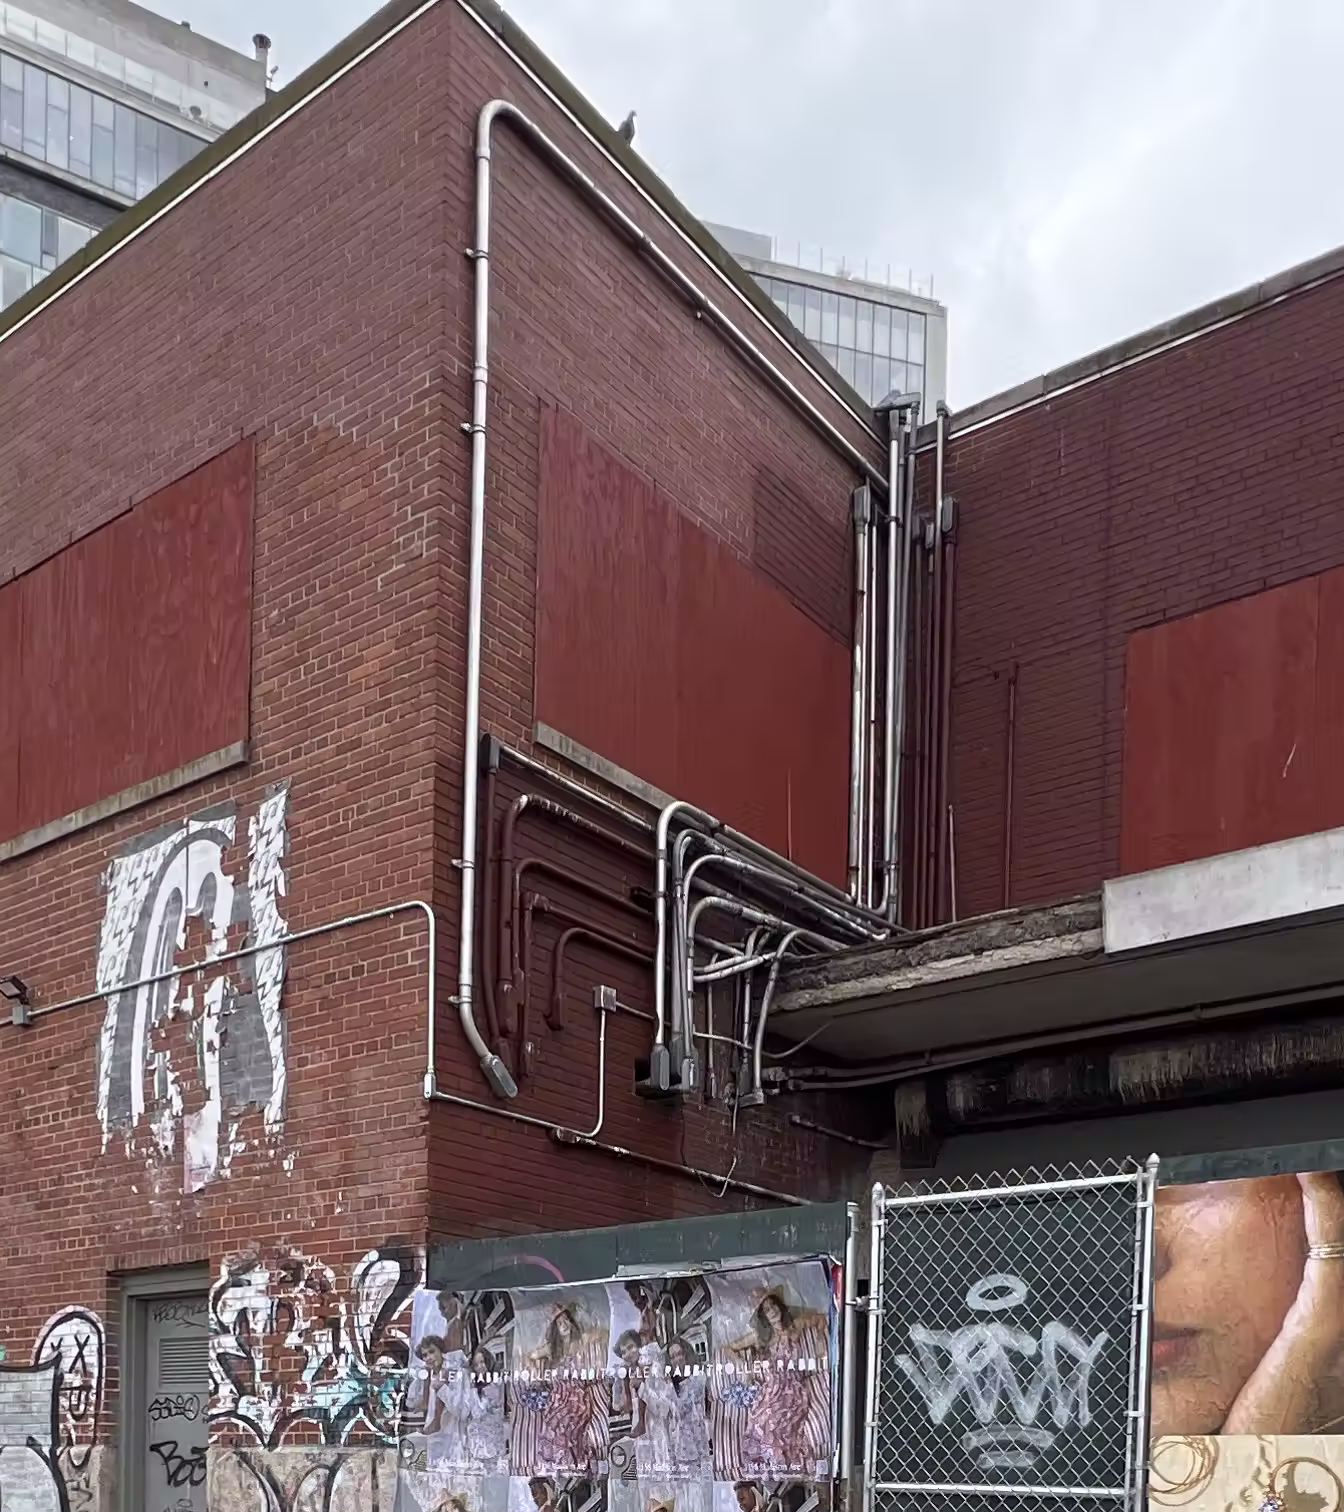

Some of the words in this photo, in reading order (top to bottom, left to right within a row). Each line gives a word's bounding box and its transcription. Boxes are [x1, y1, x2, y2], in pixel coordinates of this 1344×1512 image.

[664, 1363, 713, 1378] RABBIT
[715, 1360, 770, 1375] ROLLER
[776, 1356, 828, 1372] RABBIT
[470, 1371, 509, 1383] RABBIT
[513, 1369, 557, 1382] ROLLER
[563, 1368, 606, 1381] RABBIT
